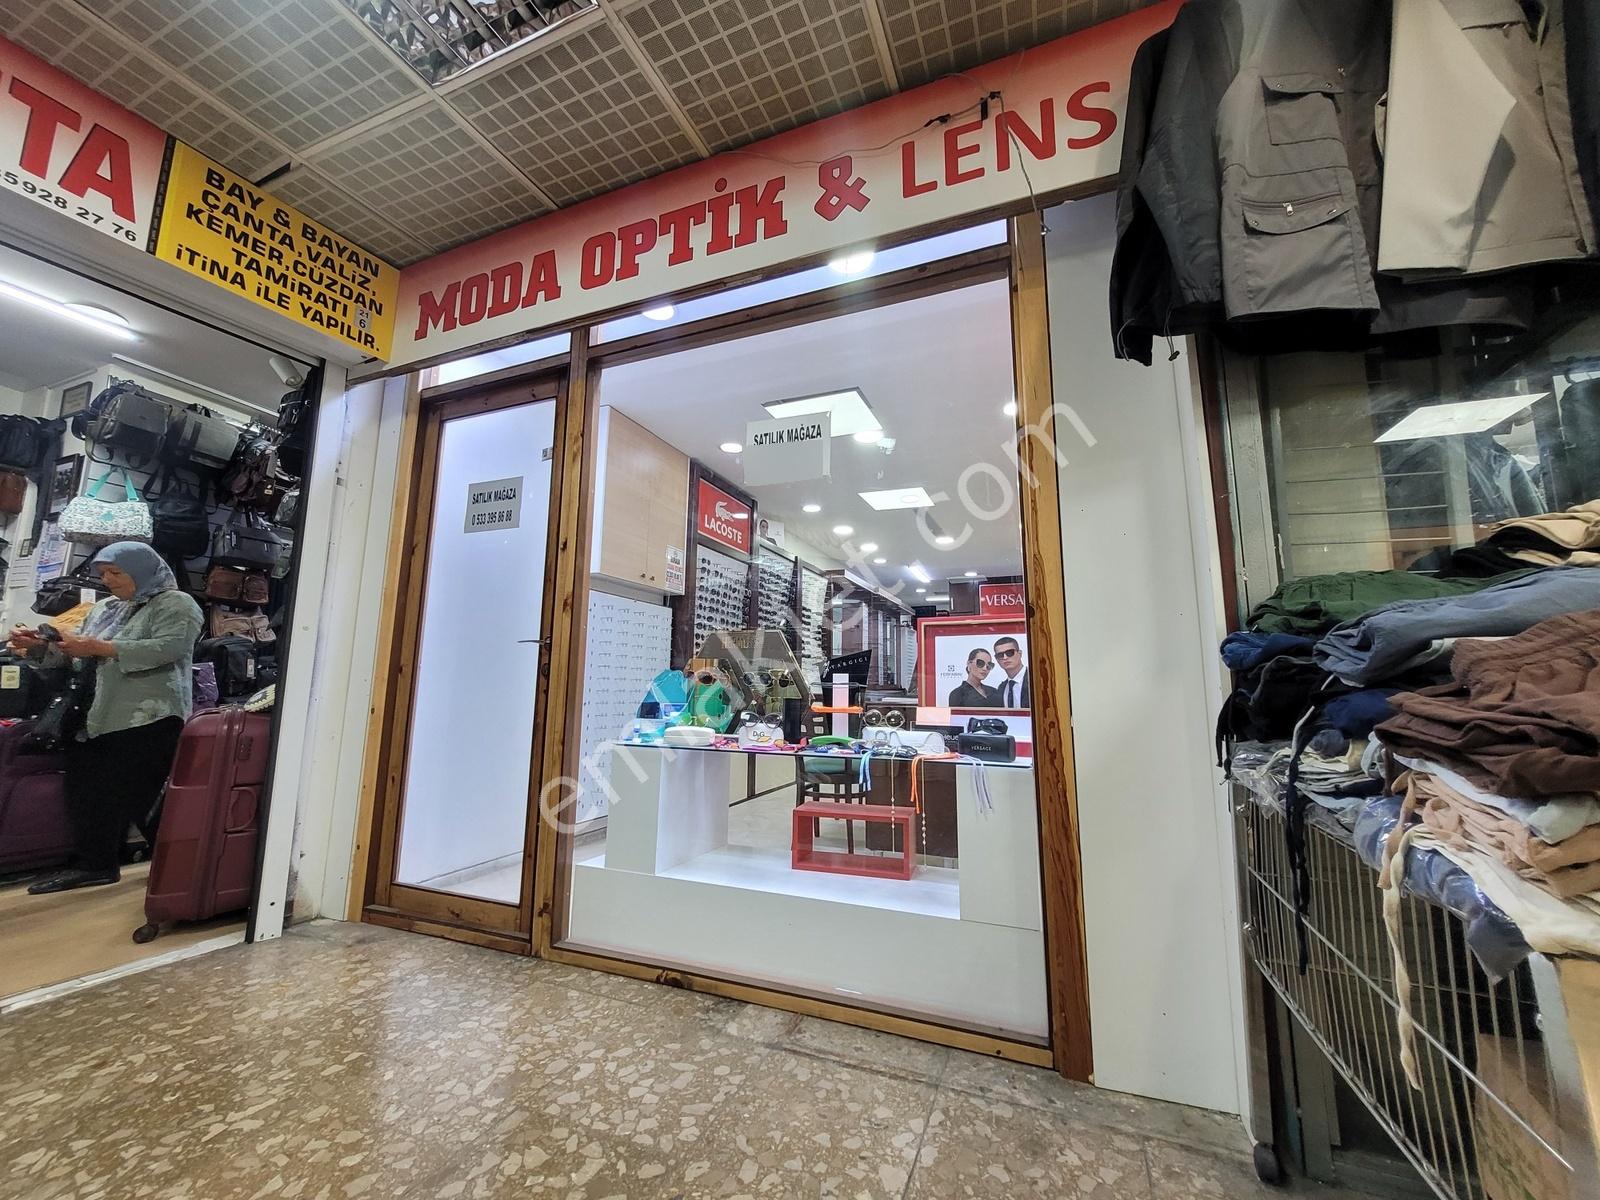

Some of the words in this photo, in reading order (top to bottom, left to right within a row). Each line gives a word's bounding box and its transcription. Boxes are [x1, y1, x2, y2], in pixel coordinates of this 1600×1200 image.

[0, 71, 136, 224] TA
[75, 206, 105, 226] 27
[111, 222, 137, 242] 76
[205, 167, 265, 212] BAY
[273, 207, 292, 230] &
[301, 222, 380, 279] BAYAN
[414, 249, 561, 341] MODA
[813, 155, 872, 222] &
[901, 81, 1119, 200] LENS
[359, 319, 366, 329] 6
[753, 430, 785, 446] SATILIK
[786, 424, 822, 443] MAĞAZA
[472, 490, 493, 505] SATILIK
[494, 486, 517, 502] MAĞAZA
[471, 514, 476, 526] 0
[476, 512, 486, 526] 533
[704, 514, 743, 544] LACOSTE
[985, 593, 1024, 606] VERSA
